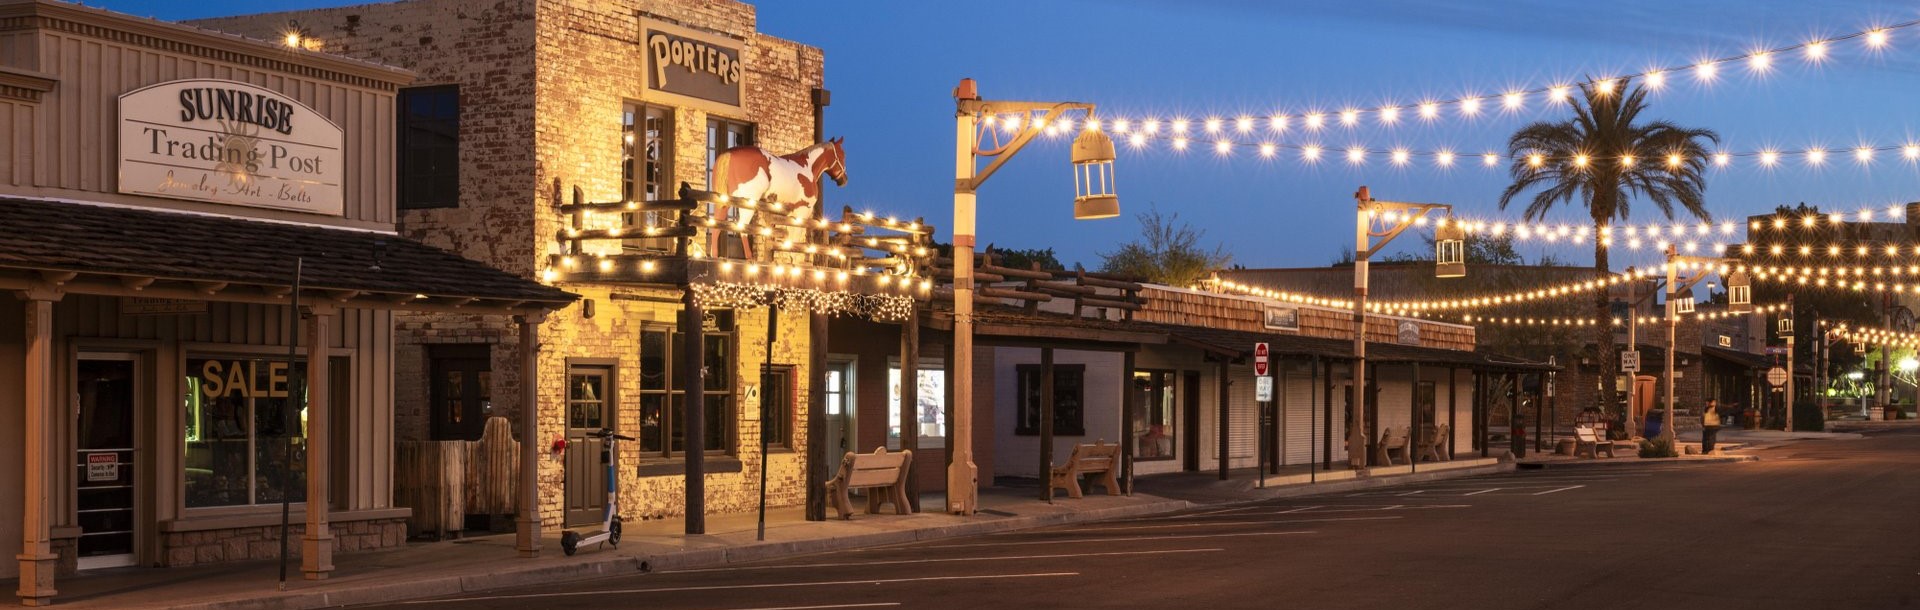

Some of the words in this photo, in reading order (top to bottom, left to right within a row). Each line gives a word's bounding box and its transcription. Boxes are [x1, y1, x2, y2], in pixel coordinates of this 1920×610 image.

[650, 34, 740, 89] PORTERS
[179, 87, 294, 135] SUNRISE
[143, 126, 260, 173] Trading
[269, 144, 323, 175] Post
[227, 182, 261, 197] Art
[277, 183, 312, 203] Belts
[202, 359, 289, 398] SALE
